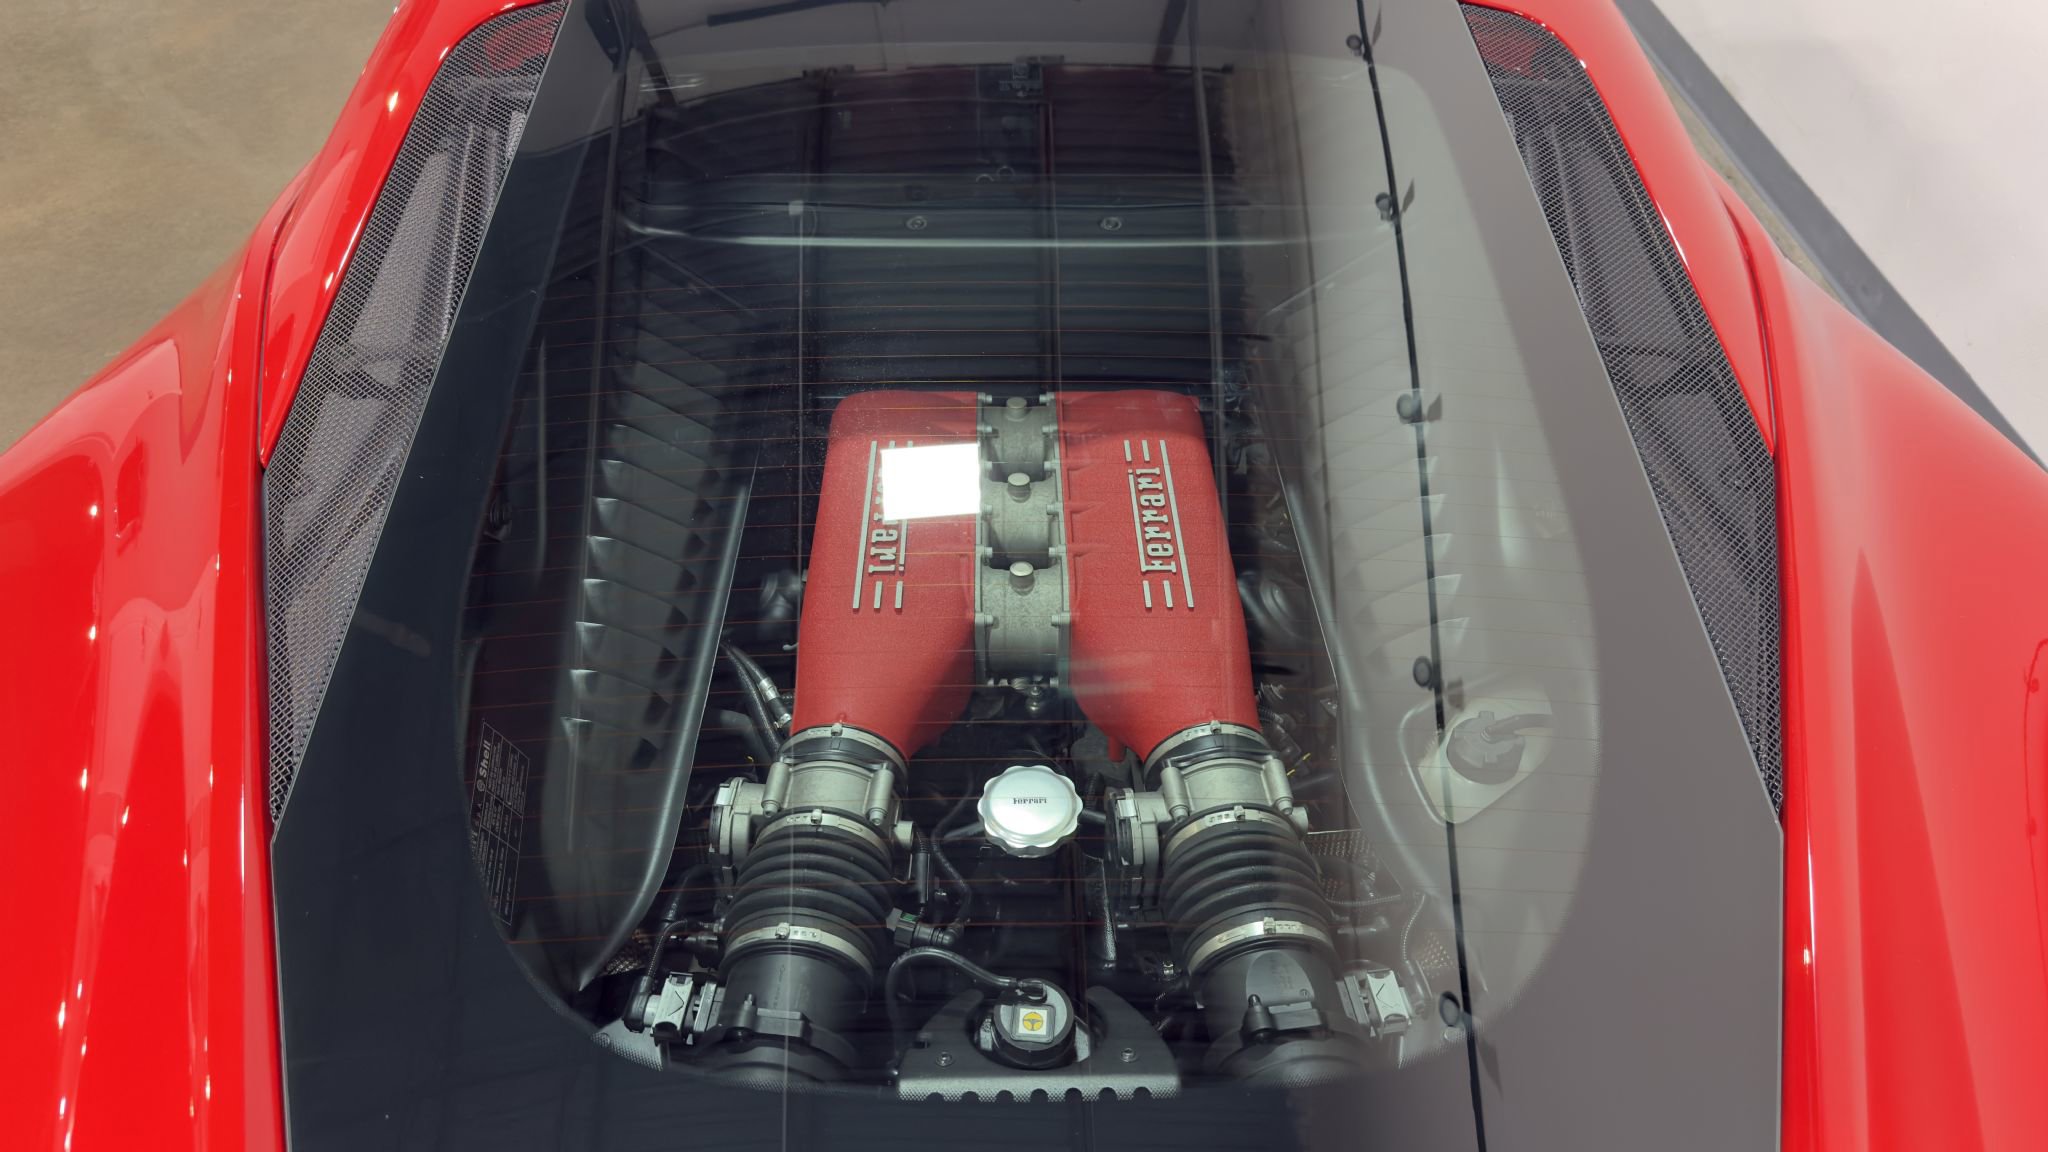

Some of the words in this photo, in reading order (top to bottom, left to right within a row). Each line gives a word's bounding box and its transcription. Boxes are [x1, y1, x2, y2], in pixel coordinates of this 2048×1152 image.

[1128, 467, 1177, 573] Ferrari
[480, 740, 491, 778] Shell
[1013, 797, 1047, 805] Ferrari
